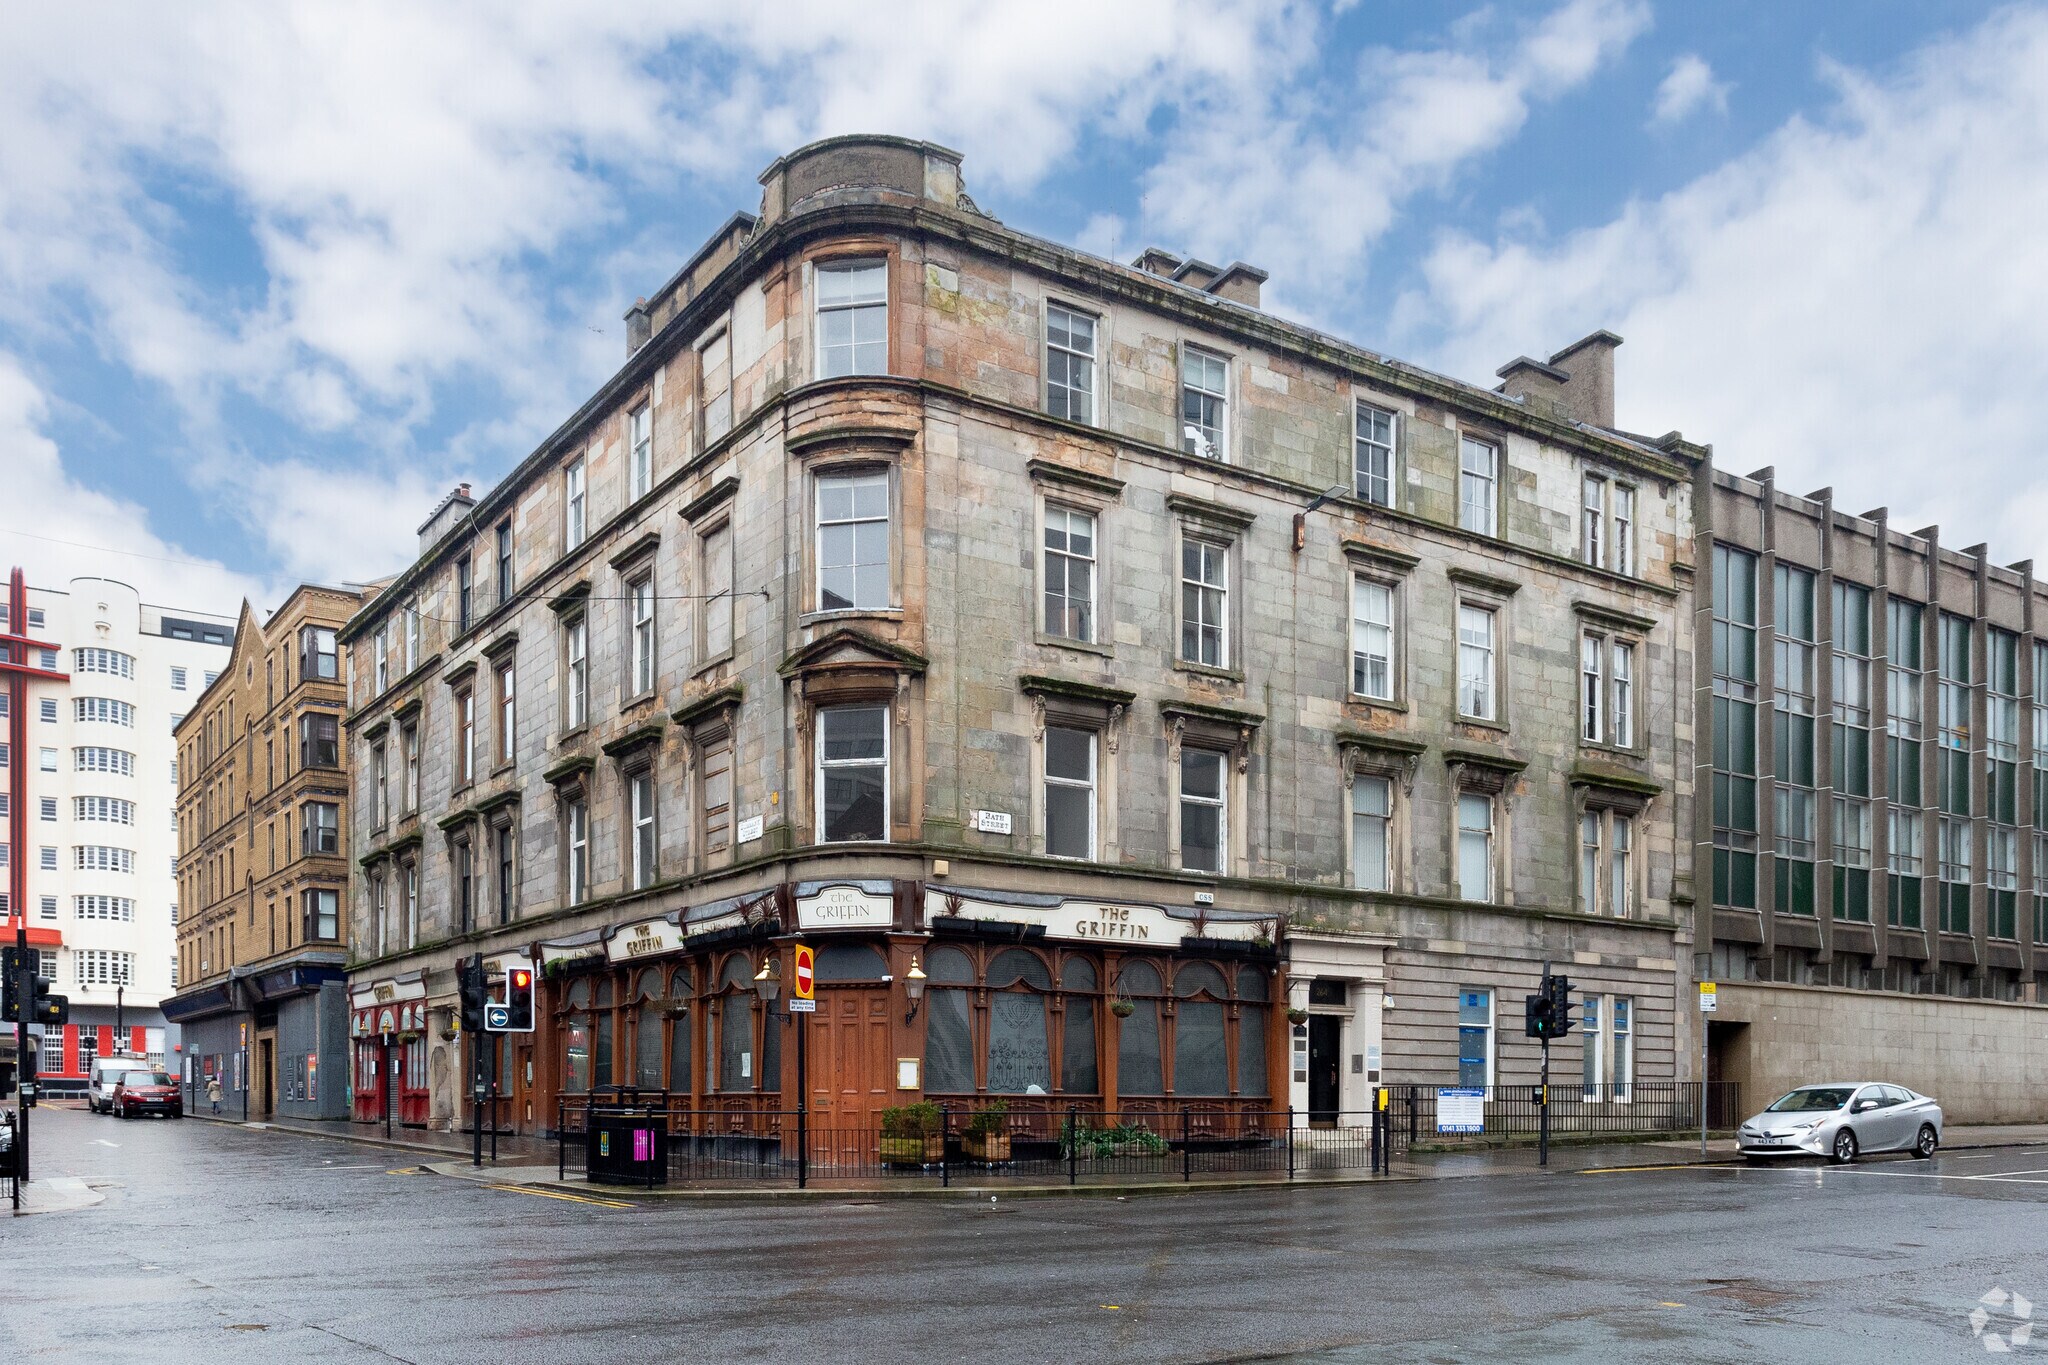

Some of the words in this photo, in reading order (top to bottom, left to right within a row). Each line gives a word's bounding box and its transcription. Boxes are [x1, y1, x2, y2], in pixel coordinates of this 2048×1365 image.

[981, 819, 1008, 828] STREET
[985, 812, 1005, 820] BATH
[815, 904, 870, 920] GRIFFIN
[1076, 920, 1149, 939] GRIFFIN
[627, 936, 663, 955] GRIFFIN
